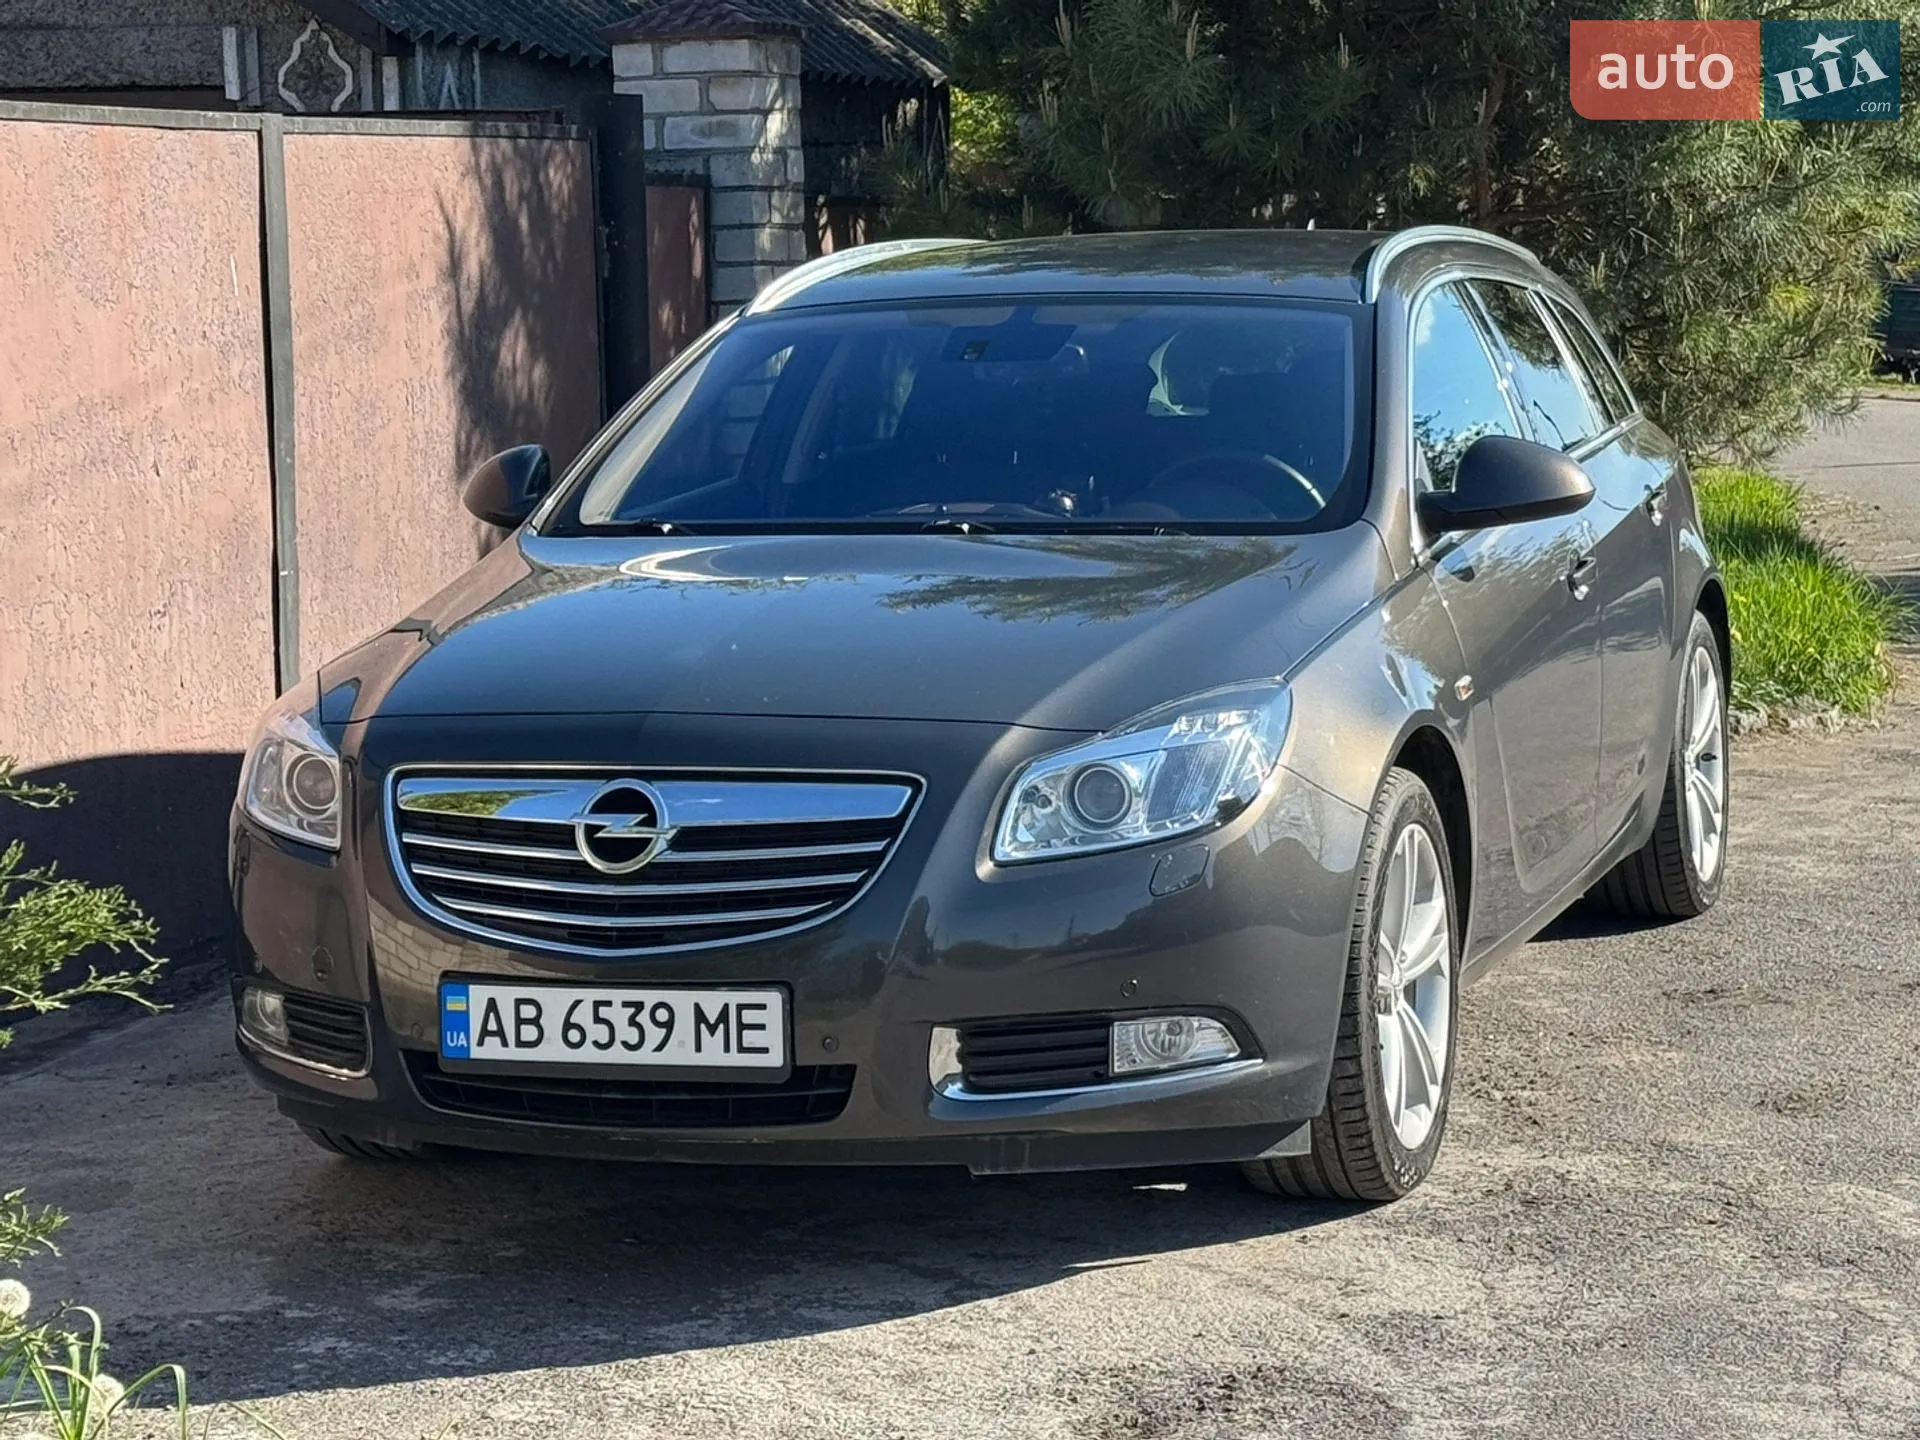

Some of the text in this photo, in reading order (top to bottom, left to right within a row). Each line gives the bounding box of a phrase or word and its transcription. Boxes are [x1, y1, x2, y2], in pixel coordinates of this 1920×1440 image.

[447, 1031, 467, 1047] UA
[476, 997, 770, 1054] AB 6539 ME
